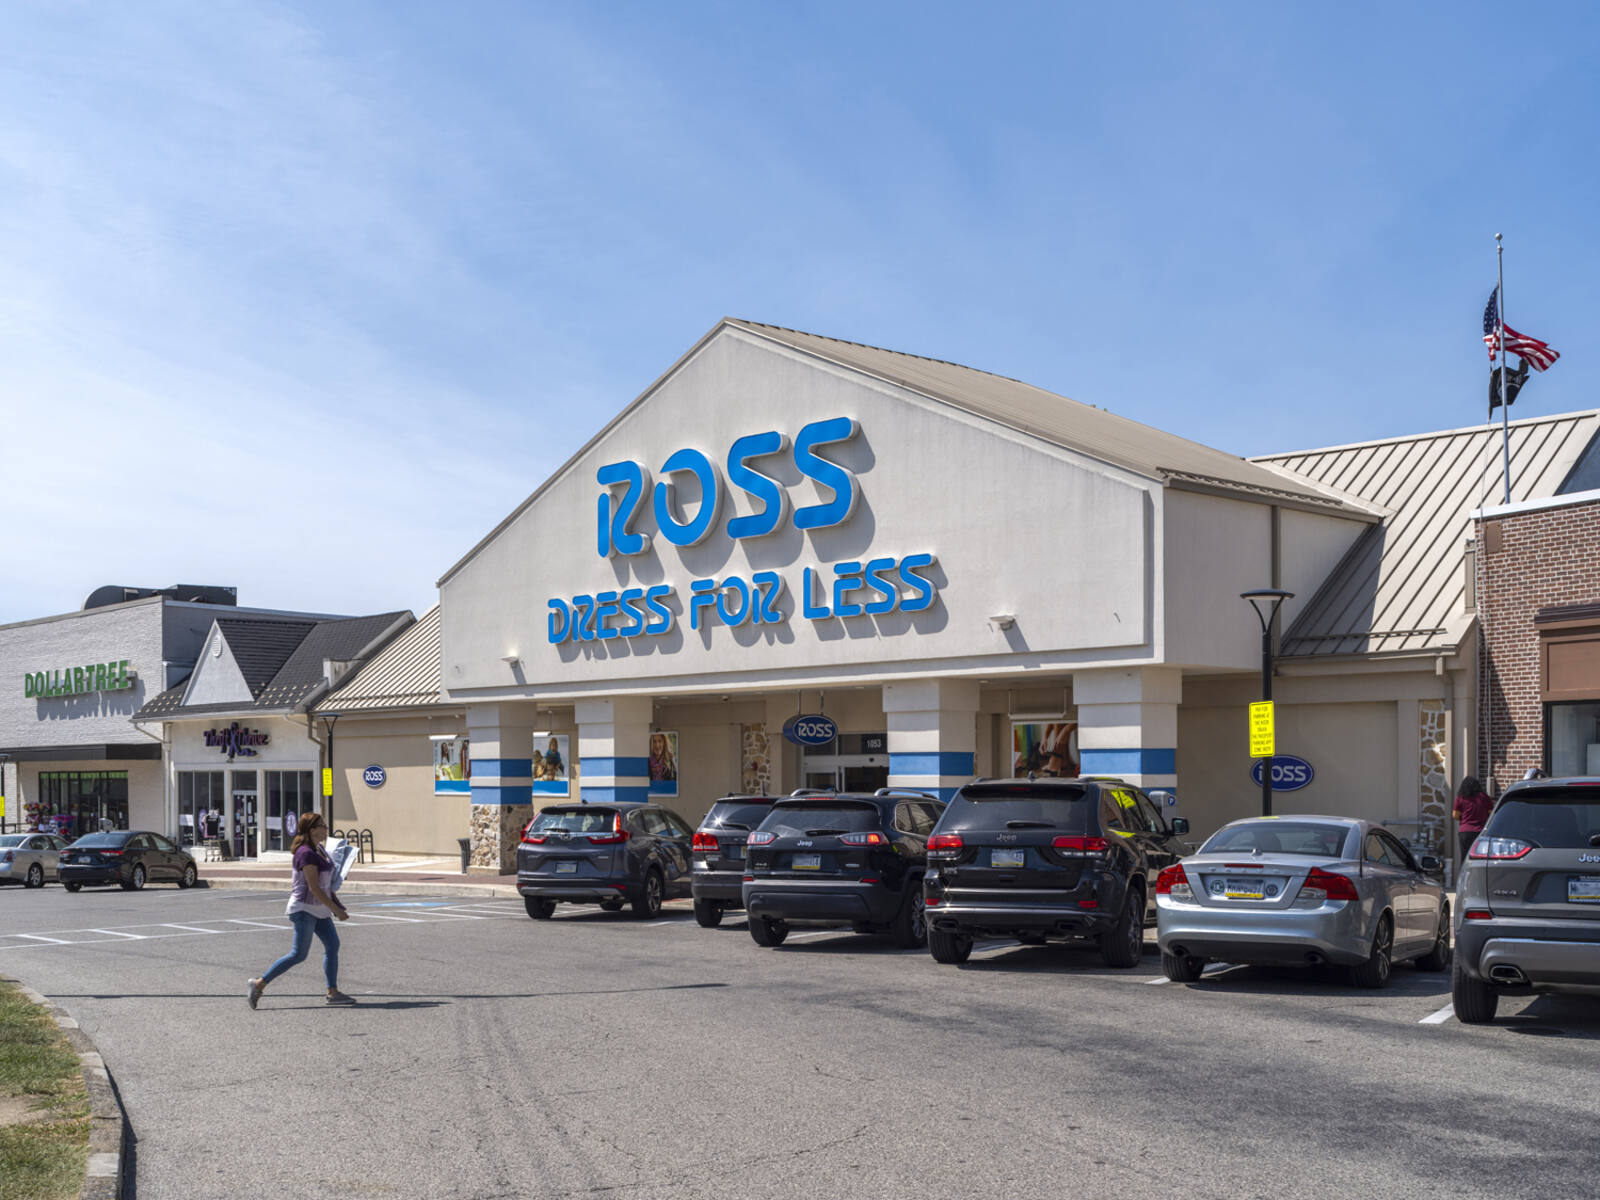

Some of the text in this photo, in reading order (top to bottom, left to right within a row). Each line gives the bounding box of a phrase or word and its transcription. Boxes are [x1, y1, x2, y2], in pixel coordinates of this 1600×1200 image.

[597, 416, 858, 558] ROSS
[548, 553, 936, 645] DRESS FOR LESS
[798, 723, 833, 737] ROSS
[365, 771, 383, 781] ROSS
[1579, 853, 1600, 862] Jee
